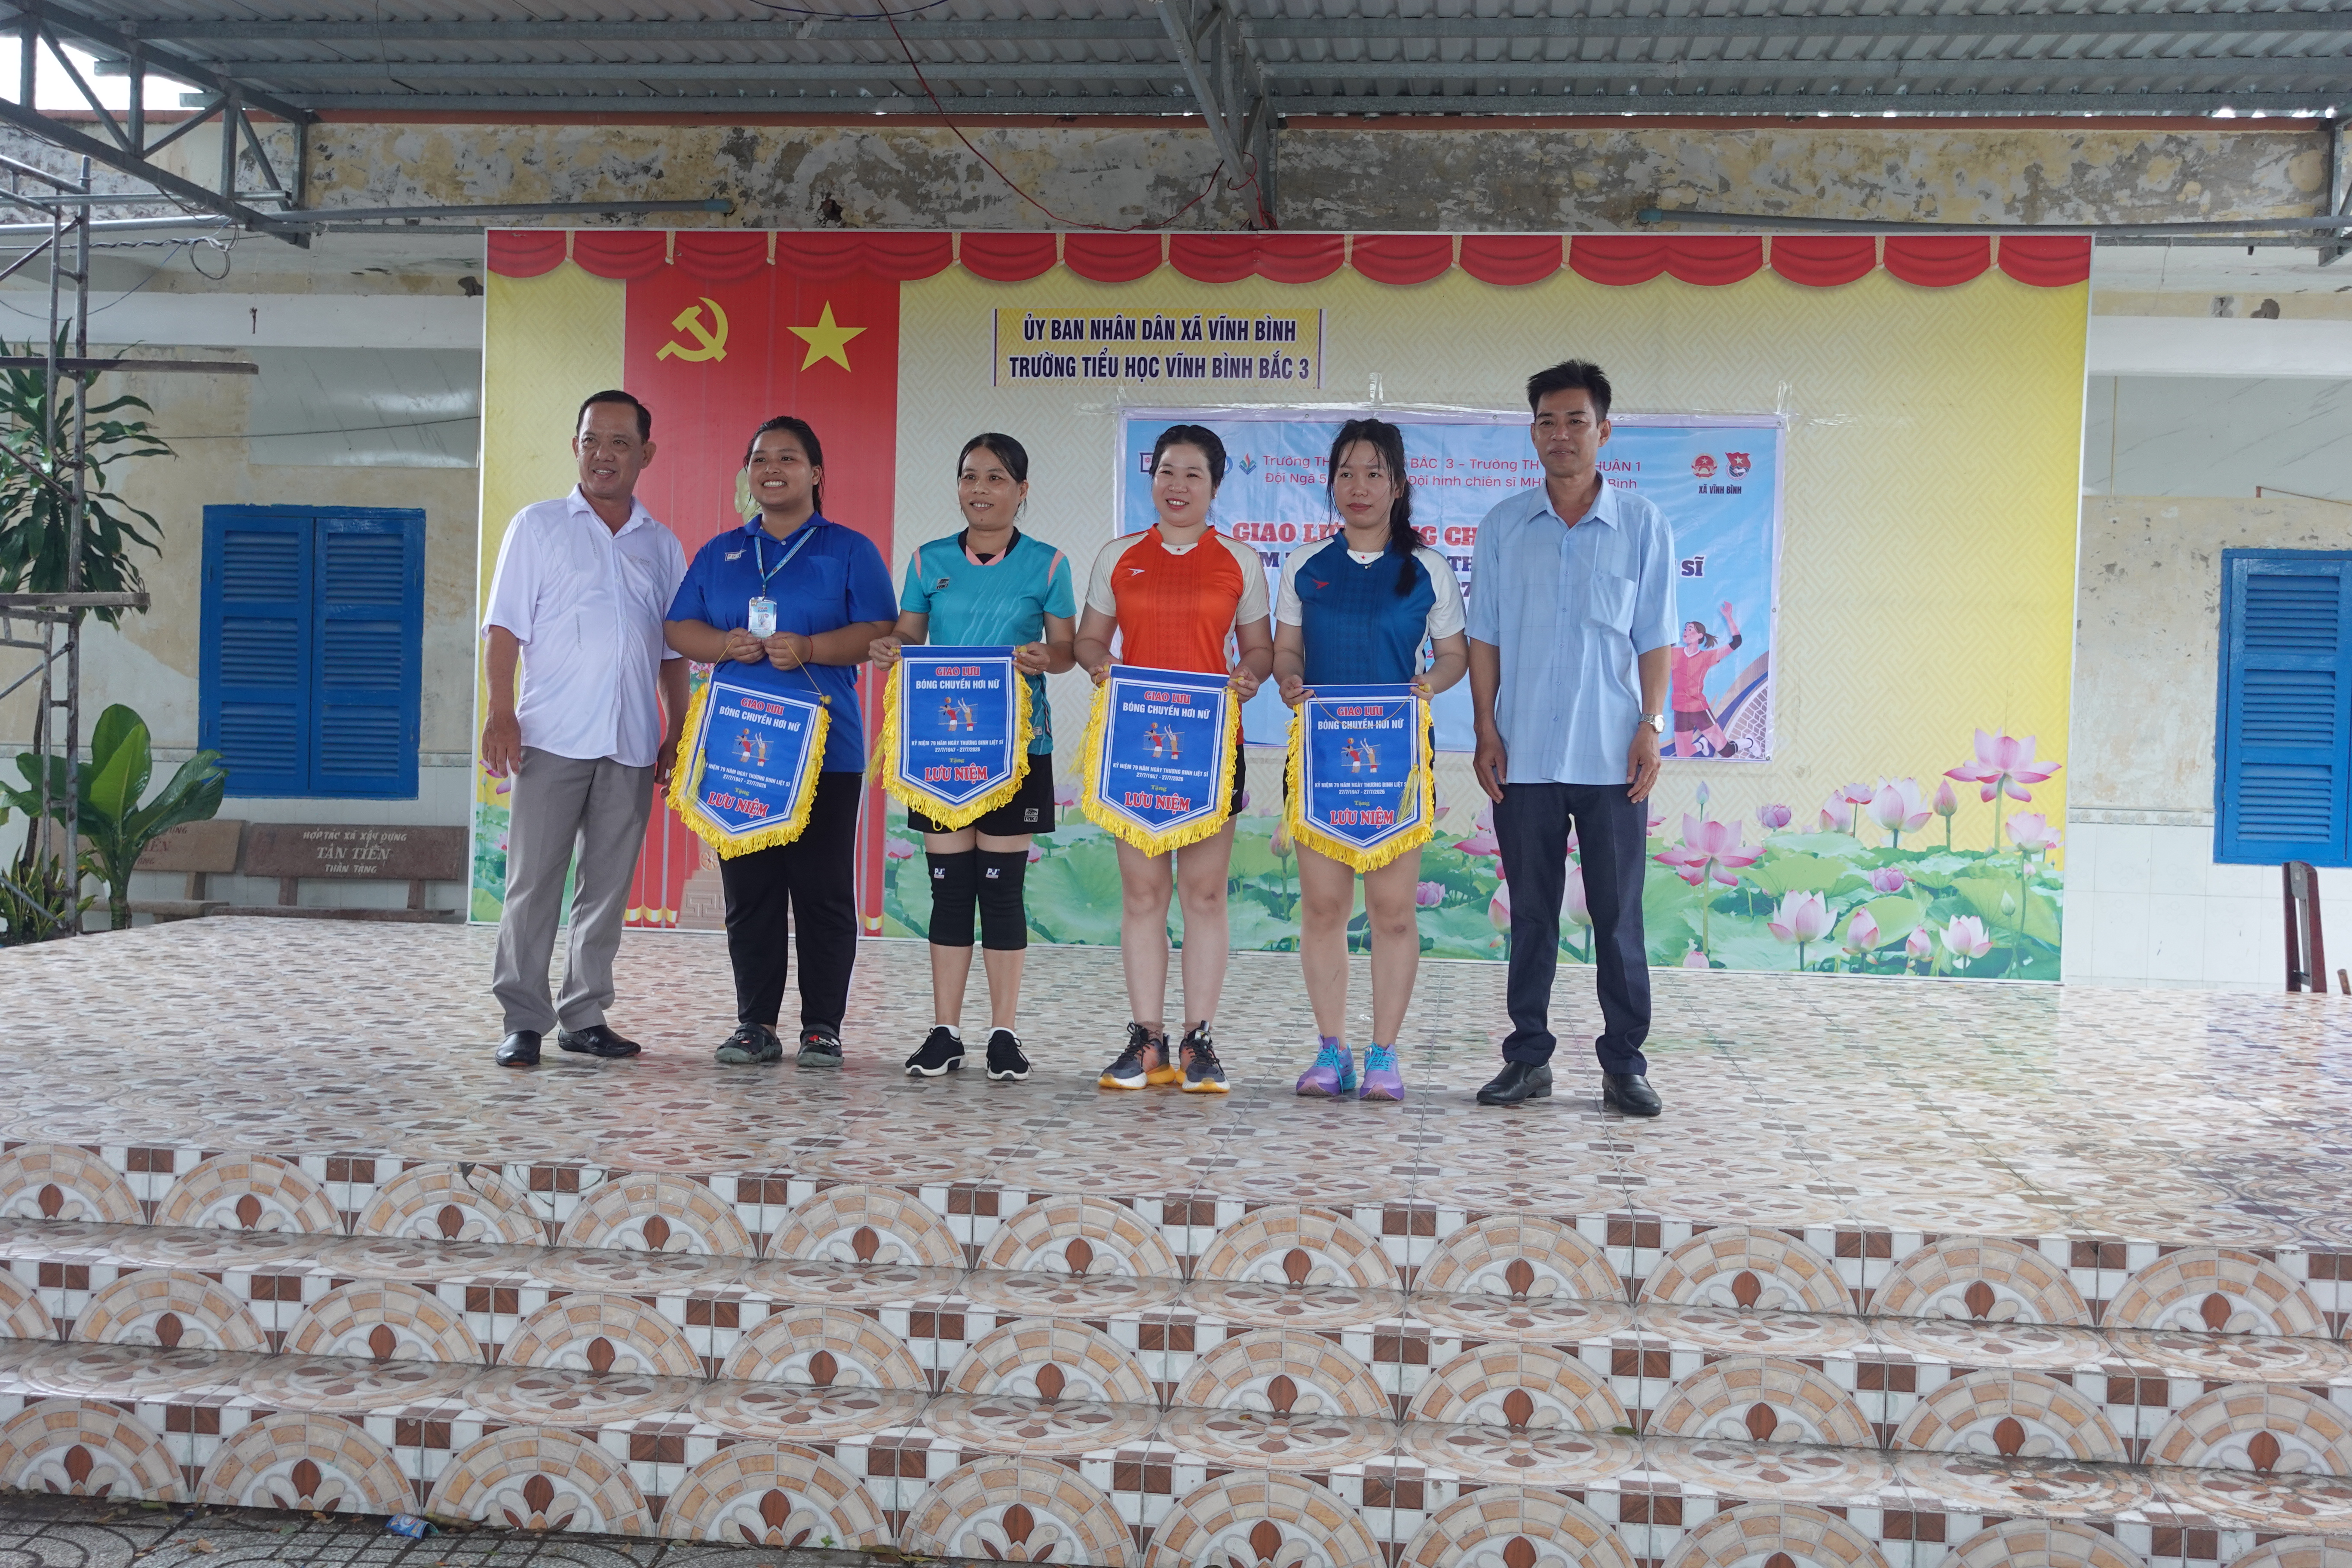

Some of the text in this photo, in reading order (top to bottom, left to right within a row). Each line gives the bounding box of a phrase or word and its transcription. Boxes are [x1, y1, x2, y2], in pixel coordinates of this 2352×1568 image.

[1024, 313, 1295, 342] ỦY BAN NHÂN DÂN XÃ VĨNH BÌNH
[1009, 348, 1309, 382] TRƯỜNG TIỂU HỌC VĨNH BÌNH BẮC 3
[1263, 456, 1310, 469] Trường
[1410, 454, 1437, 469] BẮC
[1446, 459, 1454, 469] 3
[1470, 459, 1517, 472] Trường
[1522, 460, 1539, 470] TH
[1595, 459, 1641, 473] HUẬN 1
[1265, 473, 1326, 485] Đội Ngã 5
[1408, 475, 1545, 487] Đội hình chiến sĩ MH
[1699, 484, 1742, 494] XÃ VĨNH BÌNH
[1233, 522, 1296, 542] GIAO
[1681, 556, 1704, 576] SĨ
[936, 666, 980, 676] GIAO LƯU
[916, 679, 937, 689] BÓNG
[973, 680, 986, 689] HƠI
[988, 679, 1000, 689] NỮ
[1144, 690, 1191, 704] GIAO LƯU
[741, 698, 784, 716] GIAO LƯU
[1123, 701, 1145, 713] BÓNG
[1182, 708, 1195, 718] HƠI
[1197, 709, 1210, 719] NỮ
[1337, 705, 1384, 717] GIAO LƯU
[719, 706, 740, 718] BÓNG
[773, 719, 787, 729] HƠI
[787, 722, 801, 732] NỮ
[1318, 719, 1339, 730] BÓNG
[1392, 718, 1404, 729] NỮ
[925, 763, 988, 784] LƯU NIỆM
[735, 787, 750, 796] Tặng
[707, 791, 769, 818] LƯU NIỆM
[1124, 791, 1191, 815] LƯU NIỆM
[1330, 806, 1394, 829] LƯU NIỆM
[317, 842, 348, 859] TÂN
